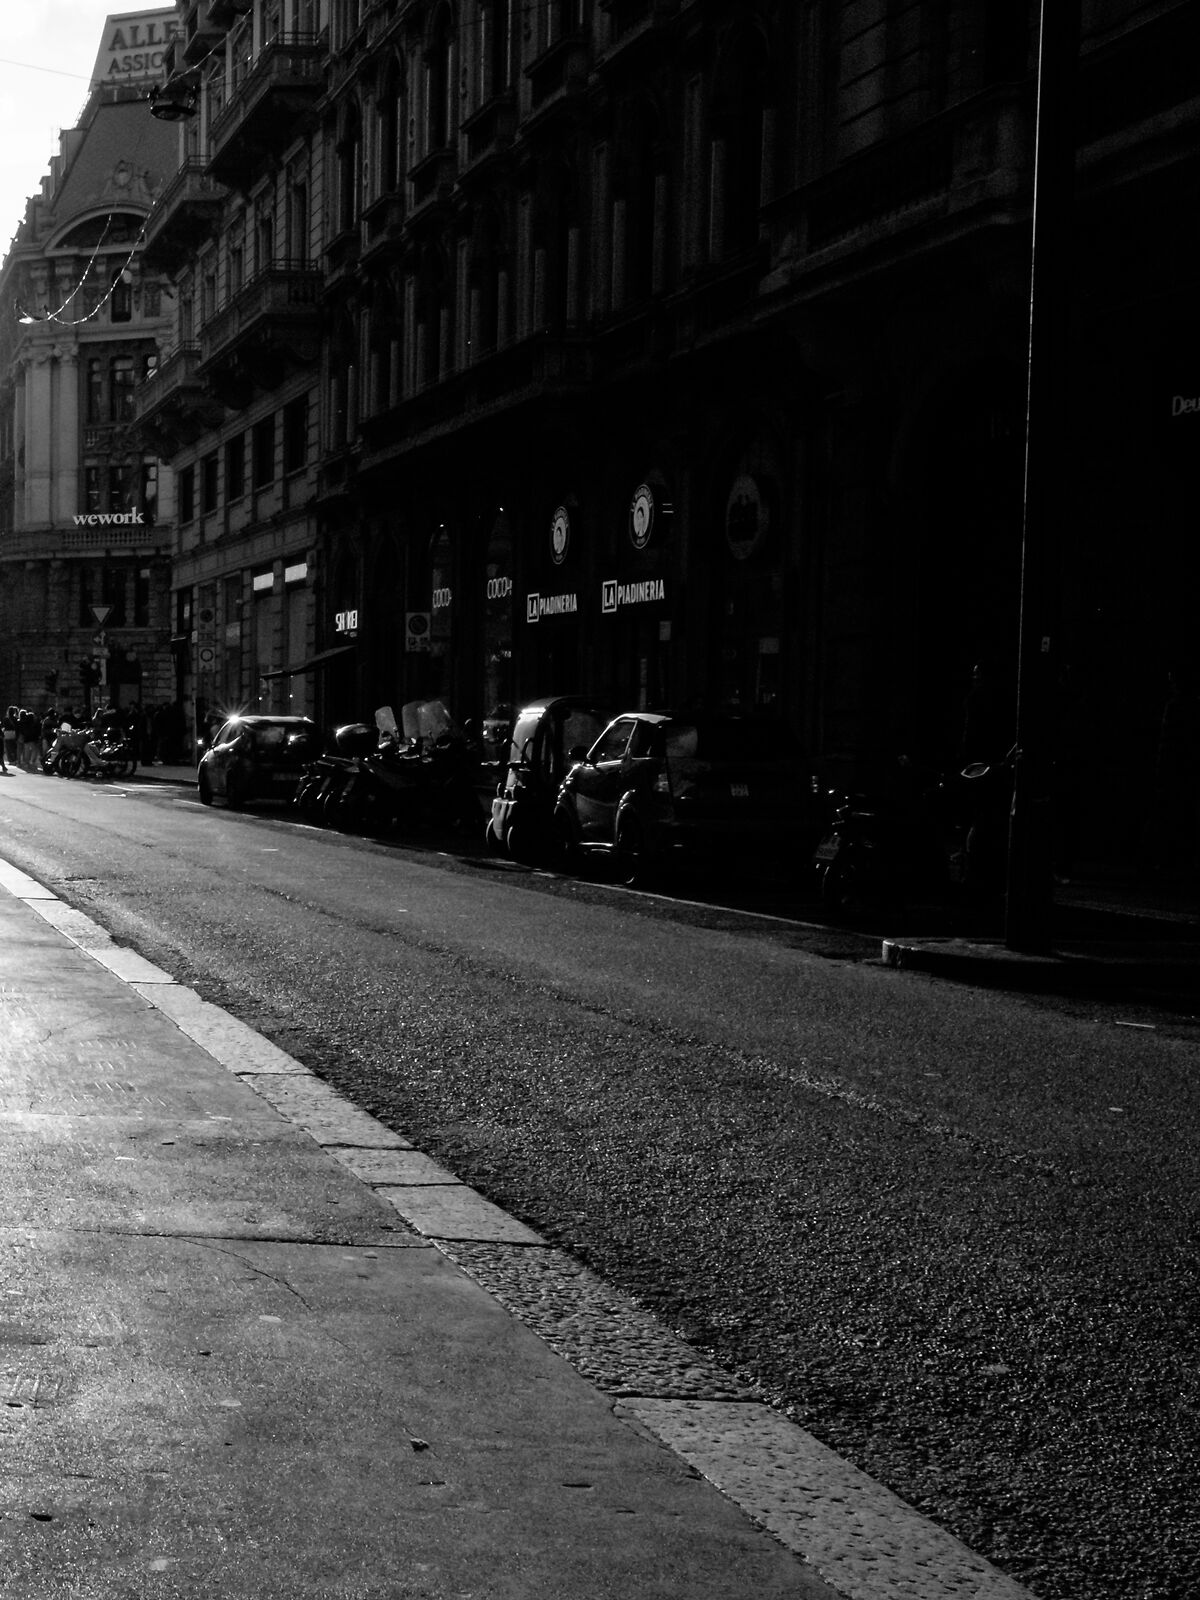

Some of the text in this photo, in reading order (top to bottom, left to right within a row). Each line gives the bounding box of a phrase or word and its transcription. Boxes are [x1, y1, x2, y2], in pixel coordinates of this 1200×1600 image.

[72, 506, 145, 526] wework
[529, 593, 578, 617] LA PIADINERIA
[605, 579, 665, 607] LA PIADINERIA
